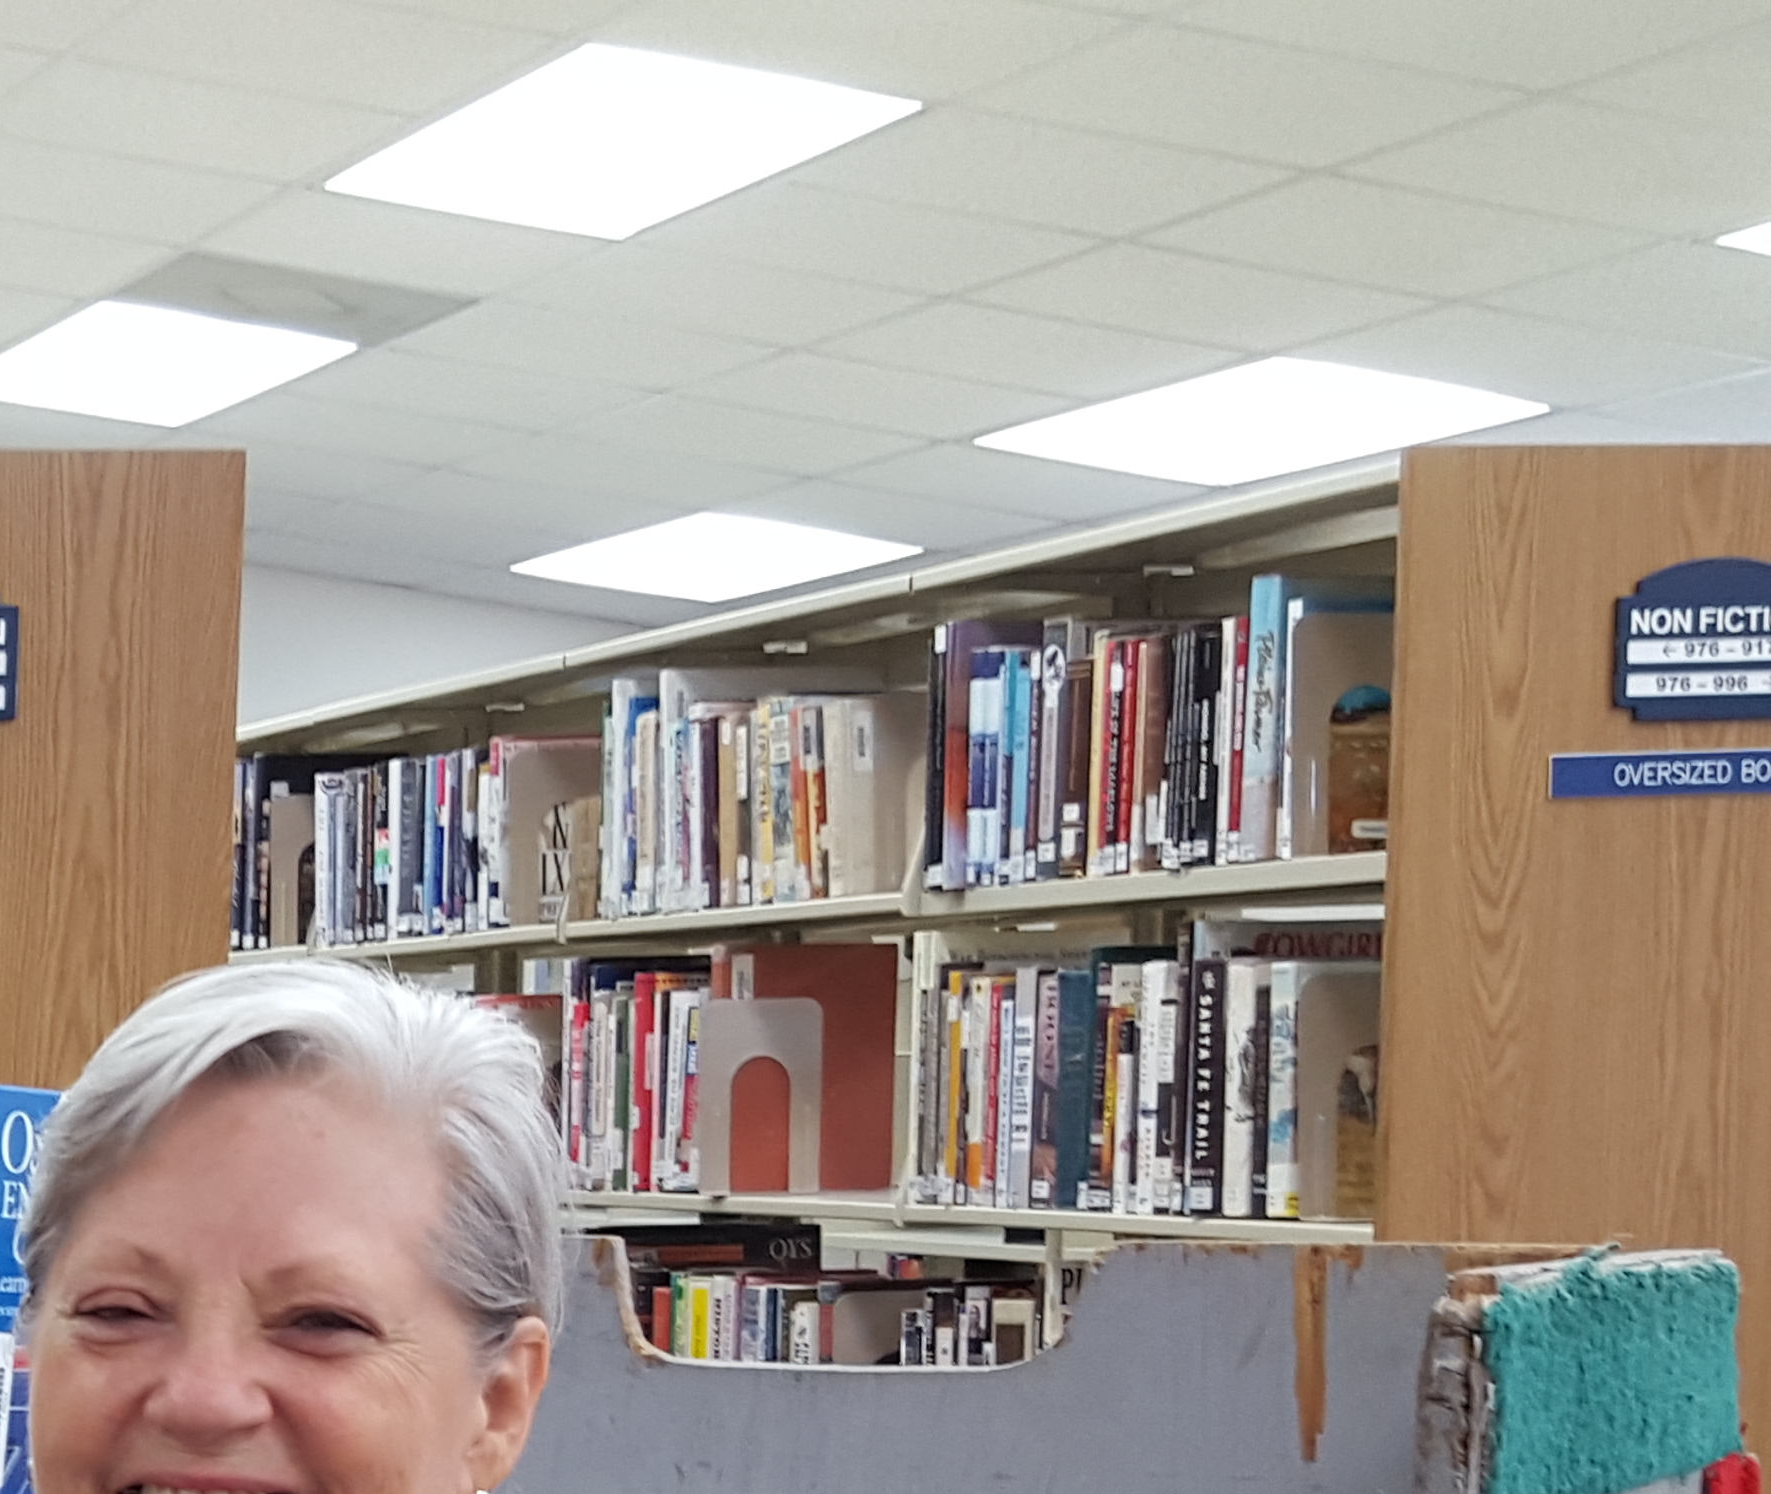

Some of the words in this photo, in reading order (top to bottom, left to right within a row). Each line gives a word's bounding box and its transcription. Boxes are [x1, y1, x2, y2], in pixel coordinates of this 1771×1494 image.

[1630, 607, 1693, 635] NON
[1684, 640, 1719, 658] 976
[1656, 675, 1691, 692] 976
[1712, 674, 1748, 691] 996
[1613, 761, 1733, 787] OVERSIZED
[1197, 994, 1215, 1062] SANTA
[1196, 1067, 1211, 1092] FE
[1194, 1100, 1210, 1161] TRAIL
